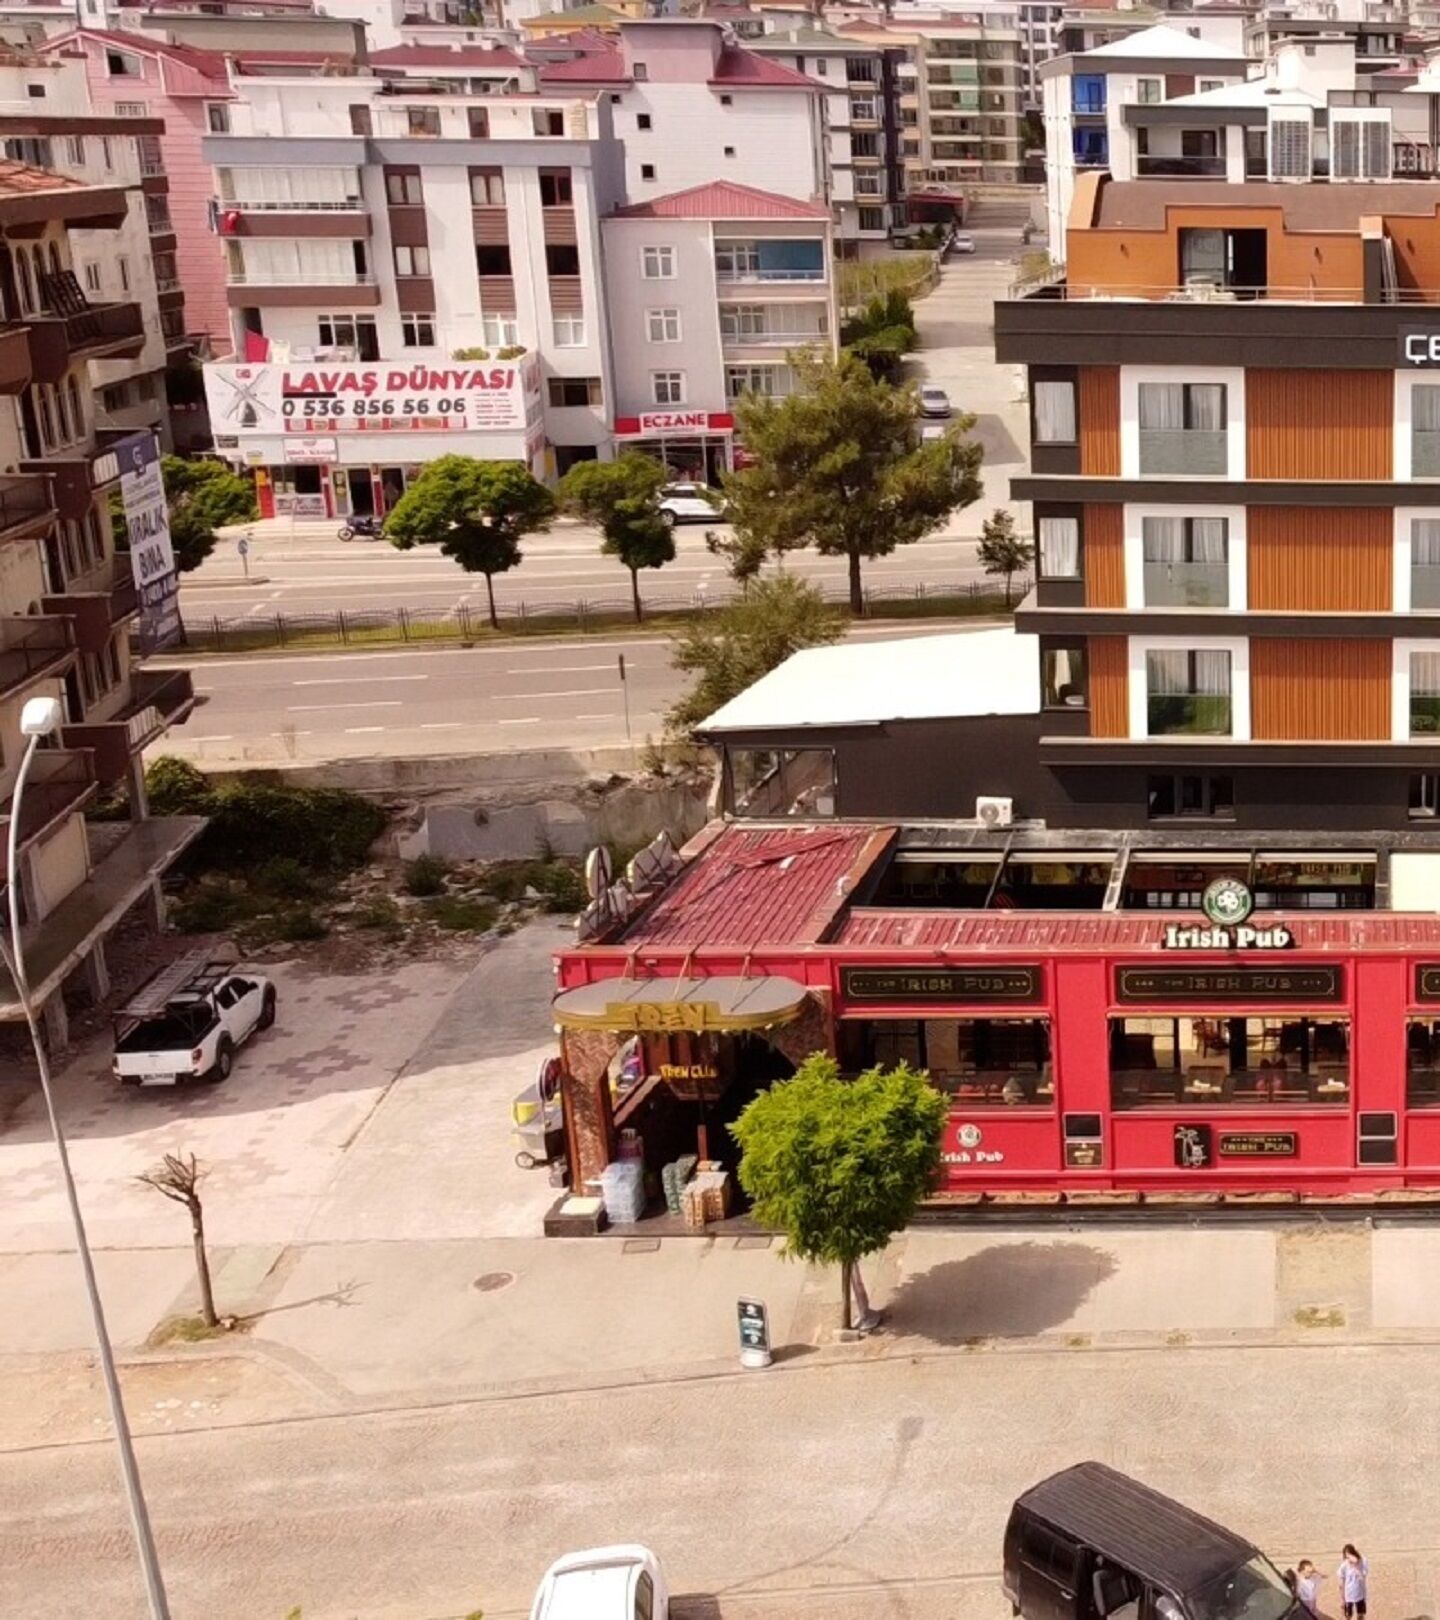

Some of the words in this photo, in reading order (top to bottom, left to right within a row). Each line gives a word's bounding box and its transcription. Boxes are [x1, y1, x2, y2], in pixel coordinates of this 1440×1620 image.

[282, 370, 379, 397] LAVAŞ
[386, 364, 515, 392] DÜNYASI
[282, 400, 295, 416] 0
[303, 400, 345, 416] 536
[352, 399, 395, 415] 856
[402, 398, 430, 415] 56
[437, 397, 466, 414] 06
[643, 413, 706, 428] ECZANE
[1166, 926, 1230, 947] Irish
[1236, 926, 1290, 947] Pub
[902, 979, 953, 991] IRISH
[964, 978, 1004, 990] PUB
[1189, 977, 1241, 989] IRISH
[1252, 977, 1291, 989] PUB
[1264, 1142, 1291, 1151] PUB
[976, 1151, 1004, 1162] Pub
